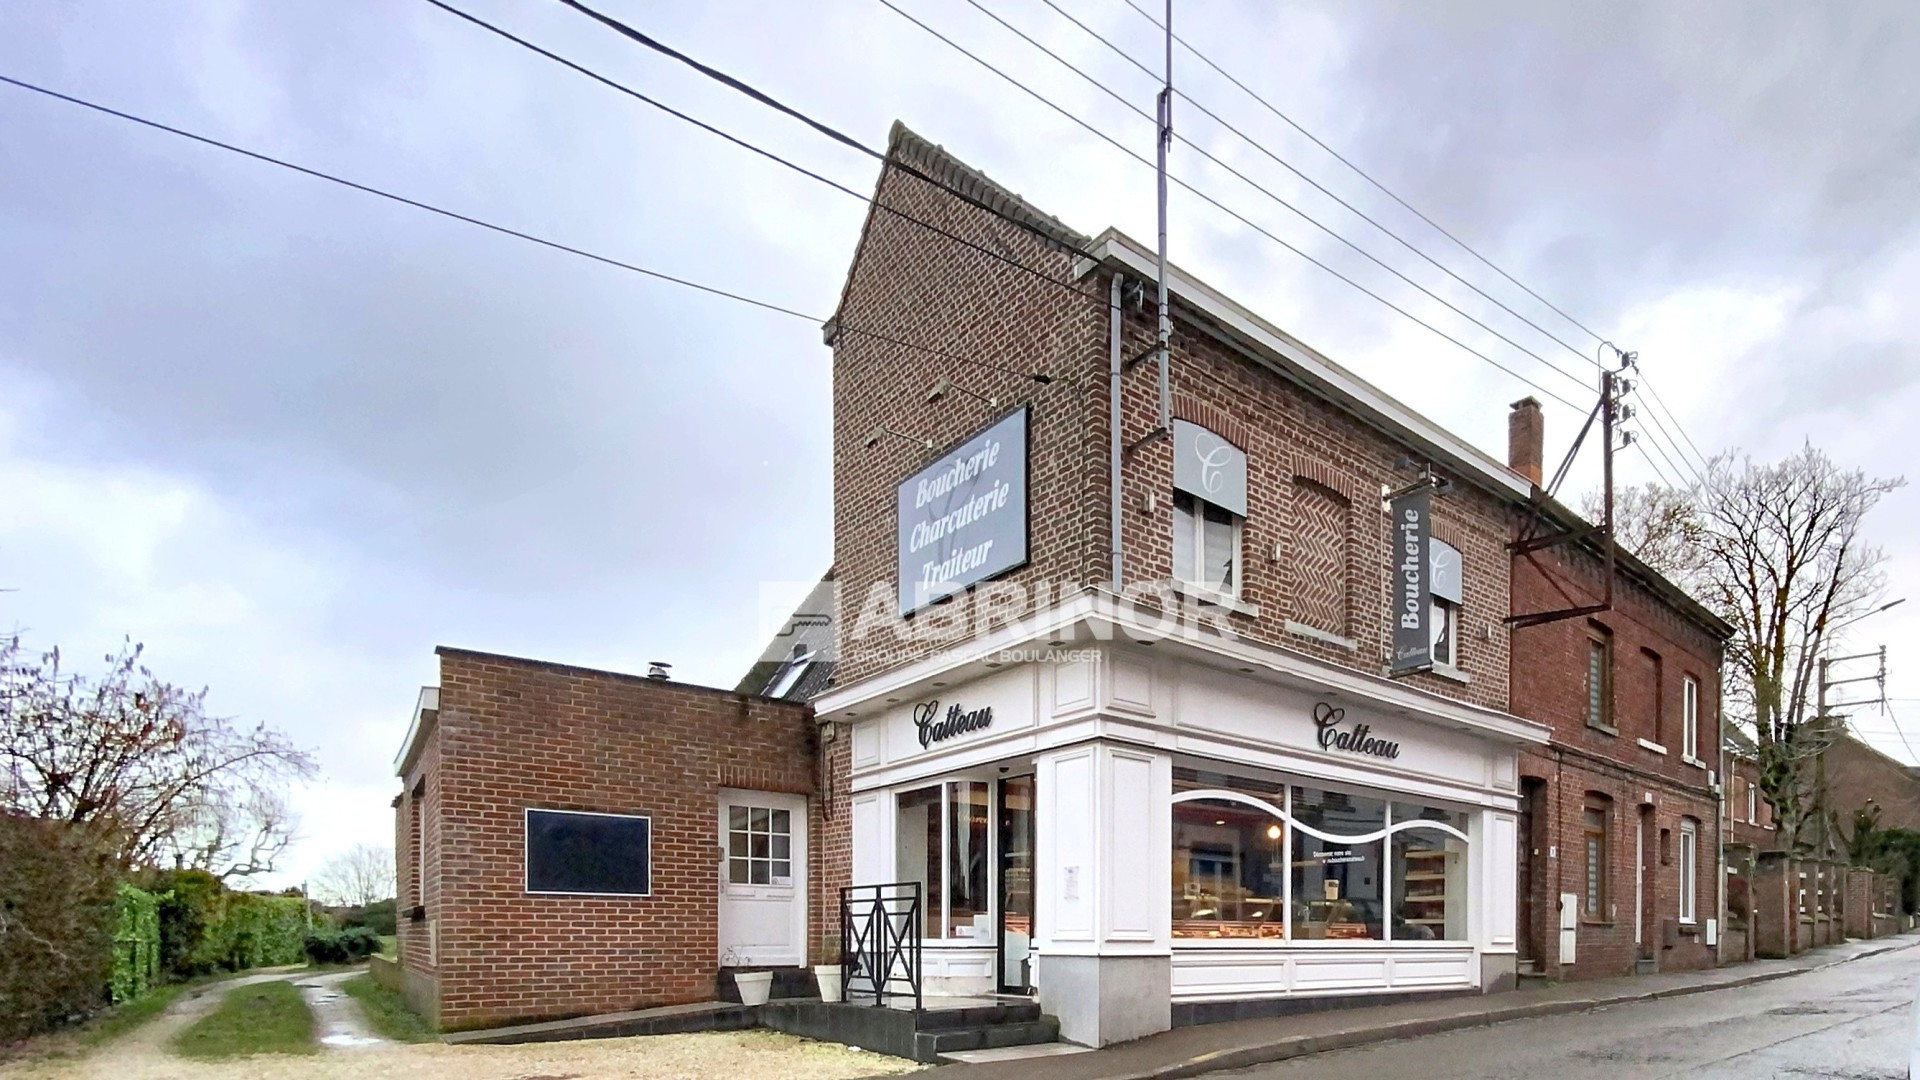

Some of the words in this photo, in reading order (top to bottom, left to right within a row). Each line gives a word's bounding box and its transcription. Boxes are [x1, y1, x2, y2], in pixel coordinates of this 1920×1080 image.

[916, 439, 1000, 509] Boucherie
[910, 479, 1009, 552] Charcuterie
[923, 539, 993, 591] Traiteur
[1401, 509, 1420, 629] Boucherie
[914, 700, 992, 750] Catteau
[1314, 702, 1399, 758] Catteau
